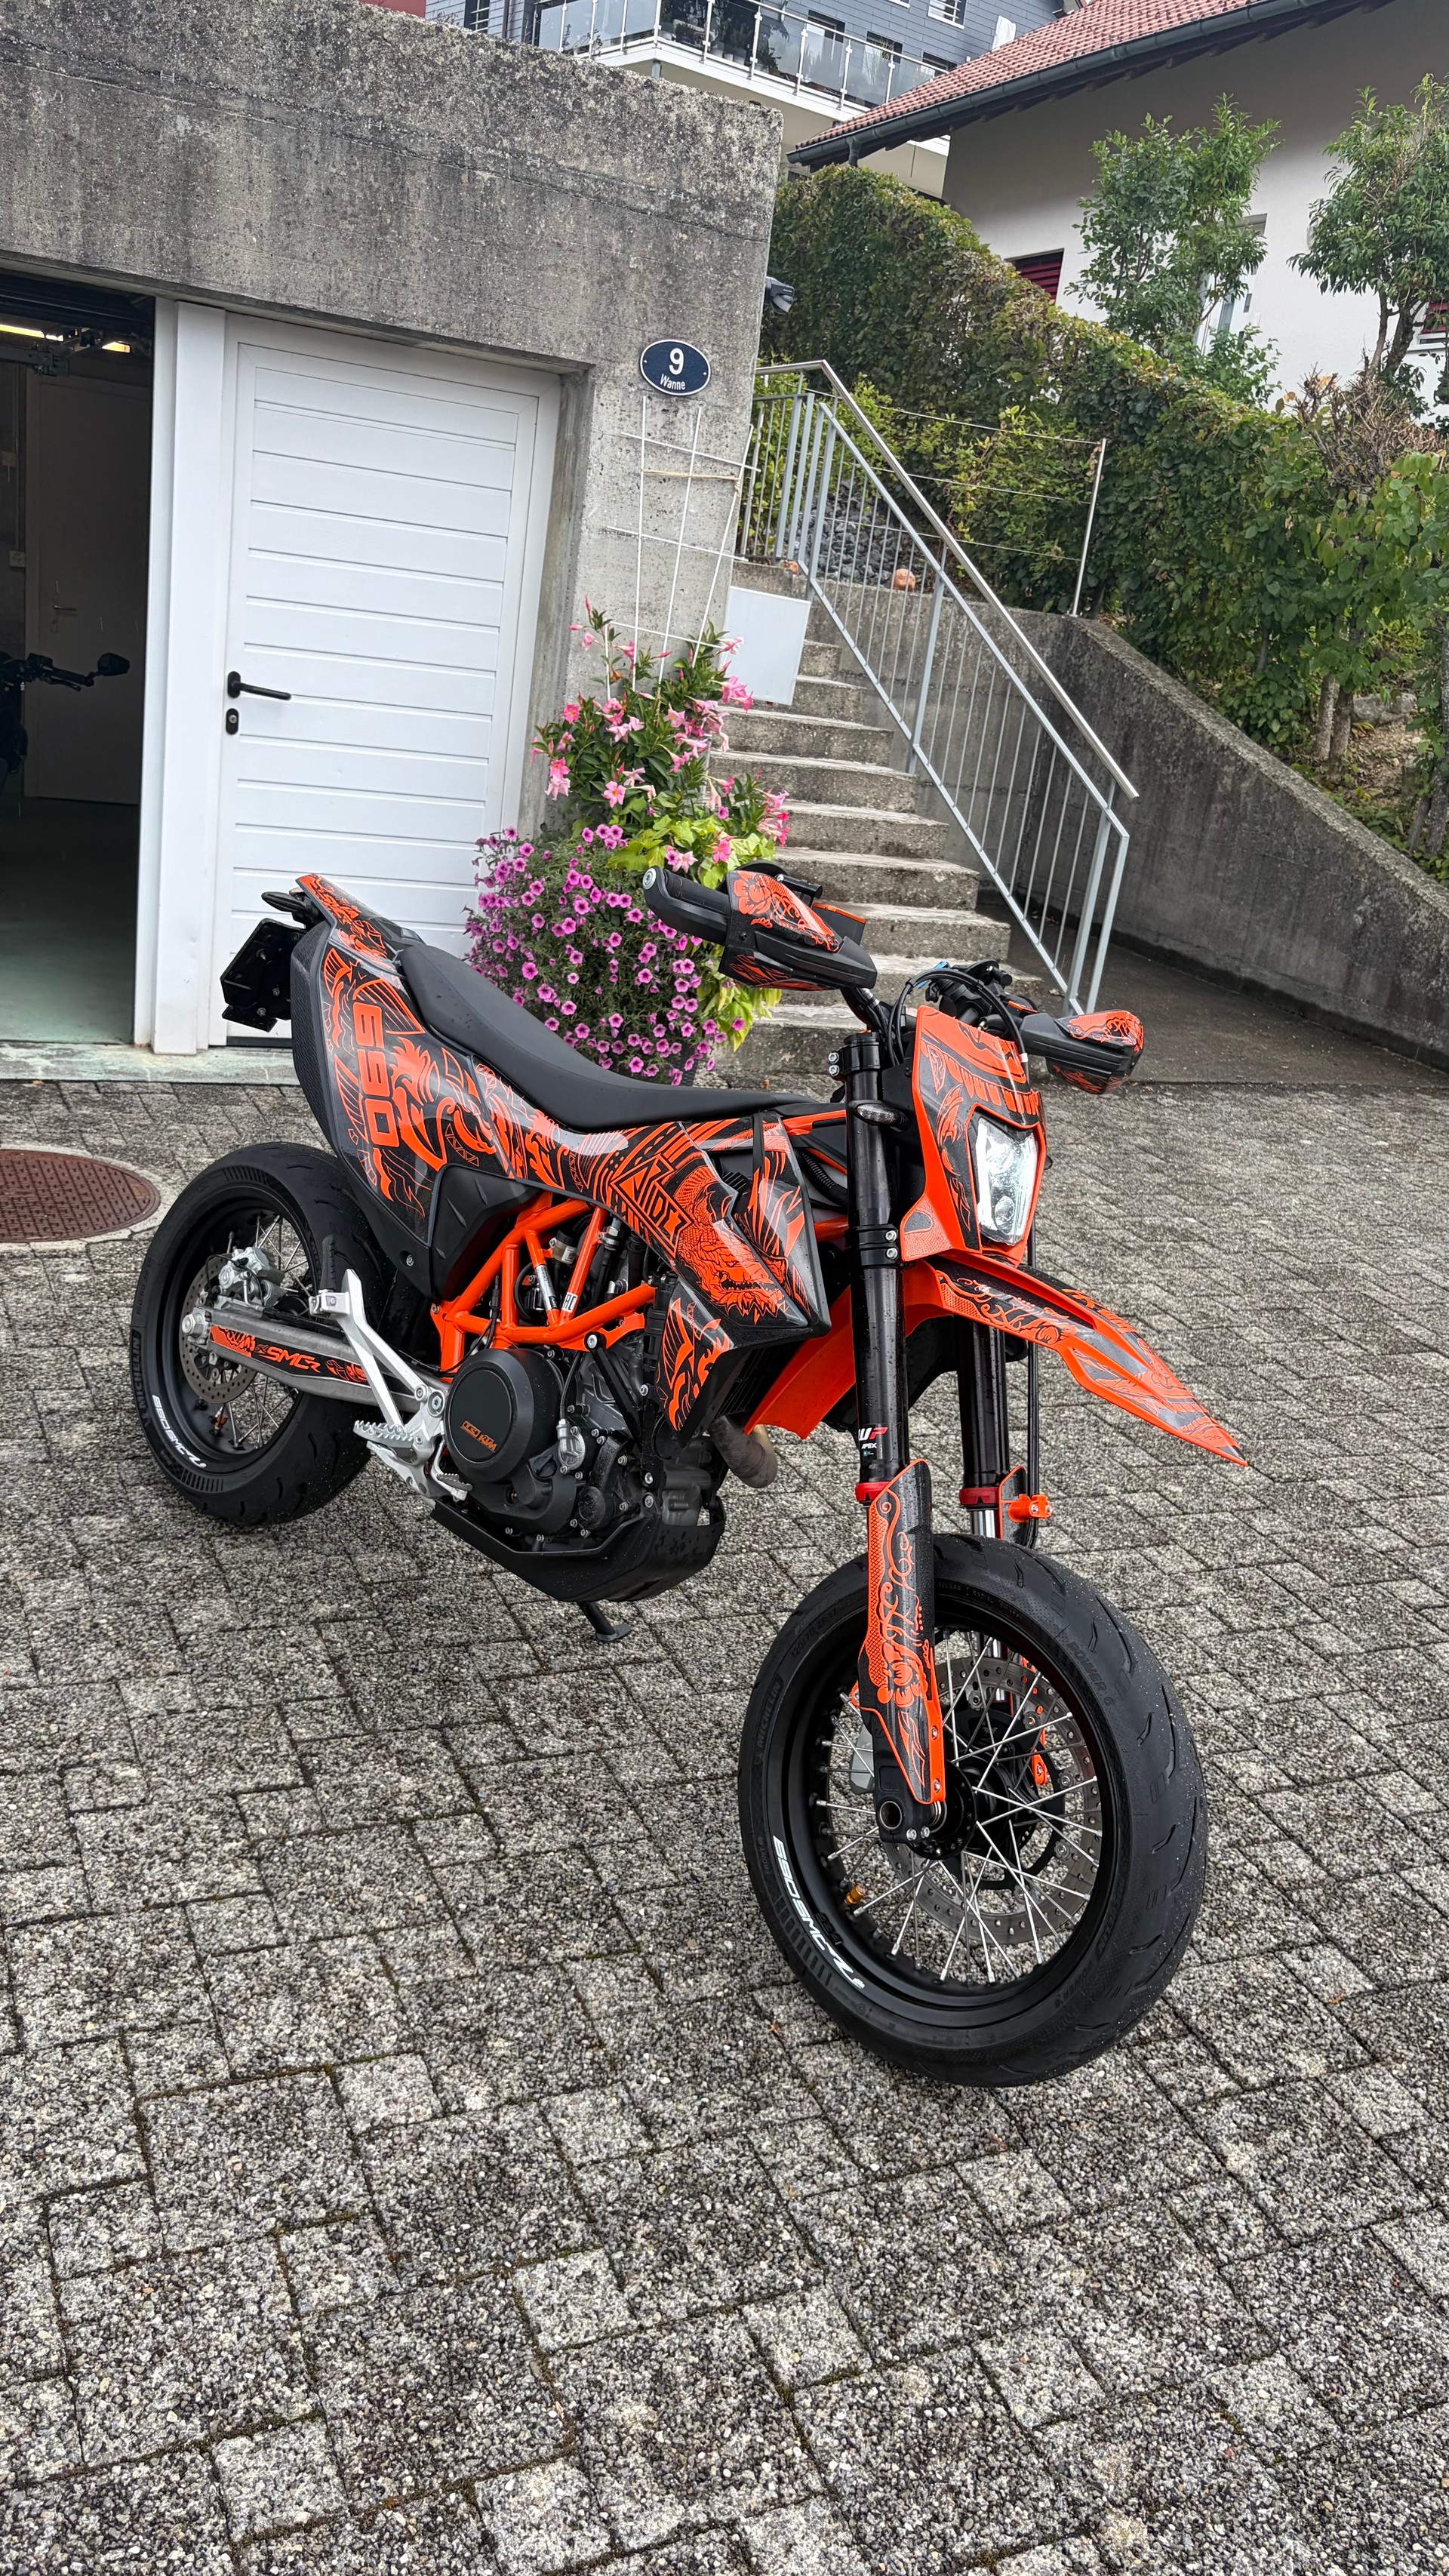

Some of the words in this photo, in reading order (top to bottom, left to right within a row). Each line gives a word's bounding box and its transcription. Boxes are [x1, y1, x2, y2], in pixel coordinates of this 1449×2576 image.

[660, 374, 686, 390] Wanne
[669, 348, 685, 375] 9
[352, 1002, 399, 1147] 690
[132, 1336, 147, 1409] MICHELIN
[478, 1433, 497, 1451] KTM
[857, 1426, 888, 1441] WP
[1066, 1640, 1108, 1691] POWER
[1103, 1694, 1115, 1707] 6
[755, 1680, 781, 1749] MICHELIN
